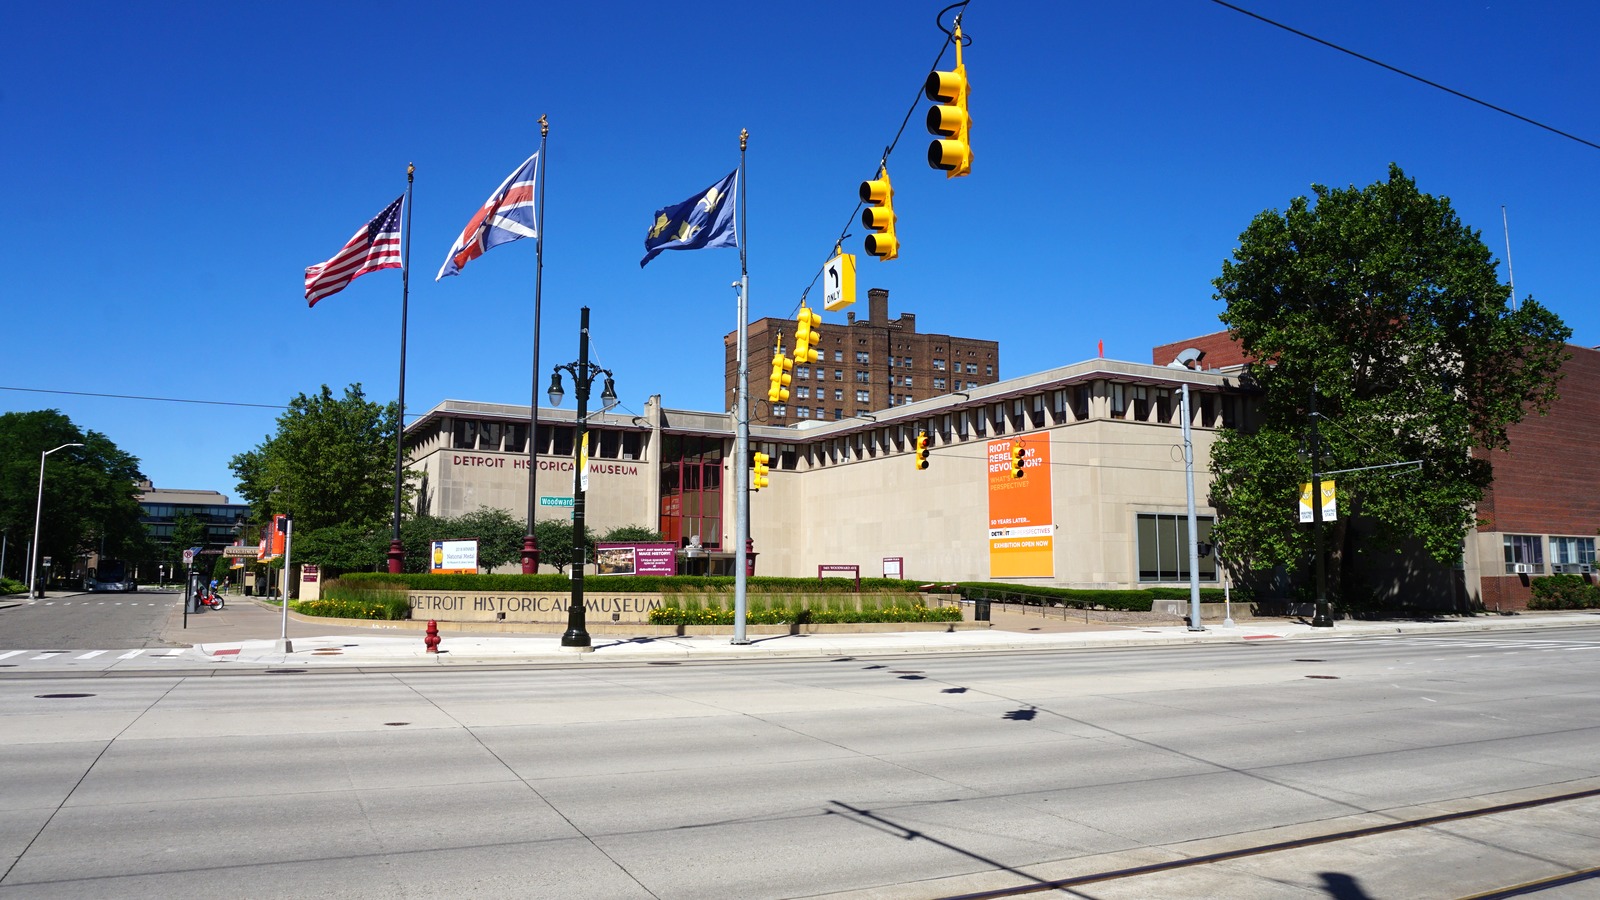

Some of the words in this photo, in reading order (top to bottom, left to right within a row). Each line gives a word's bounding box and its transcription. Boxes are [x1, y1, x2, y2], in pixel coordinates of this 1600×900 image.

[826, 290, 840, 304] ONLY
[990, 442, 1010, 453] RIOT?
[990, 448, 1035, 463] REBELN?
[454, 456, 505, 468] DETROIT
[514, 459, 574, 472] HISTORICA
[590, 464, 638, 476] MUSEUM
[990, 458, 1042, 472] REVOLION?
[990, 475, 1010, 483] WHAT'S
[990, 480, 1030, 490] PERSPECTIVE?
[409, 596, 466, 610] DETROIT
[473, 597, 570, 612] HISTORICAL
[584, 598, 662, 612] MUSEUM
